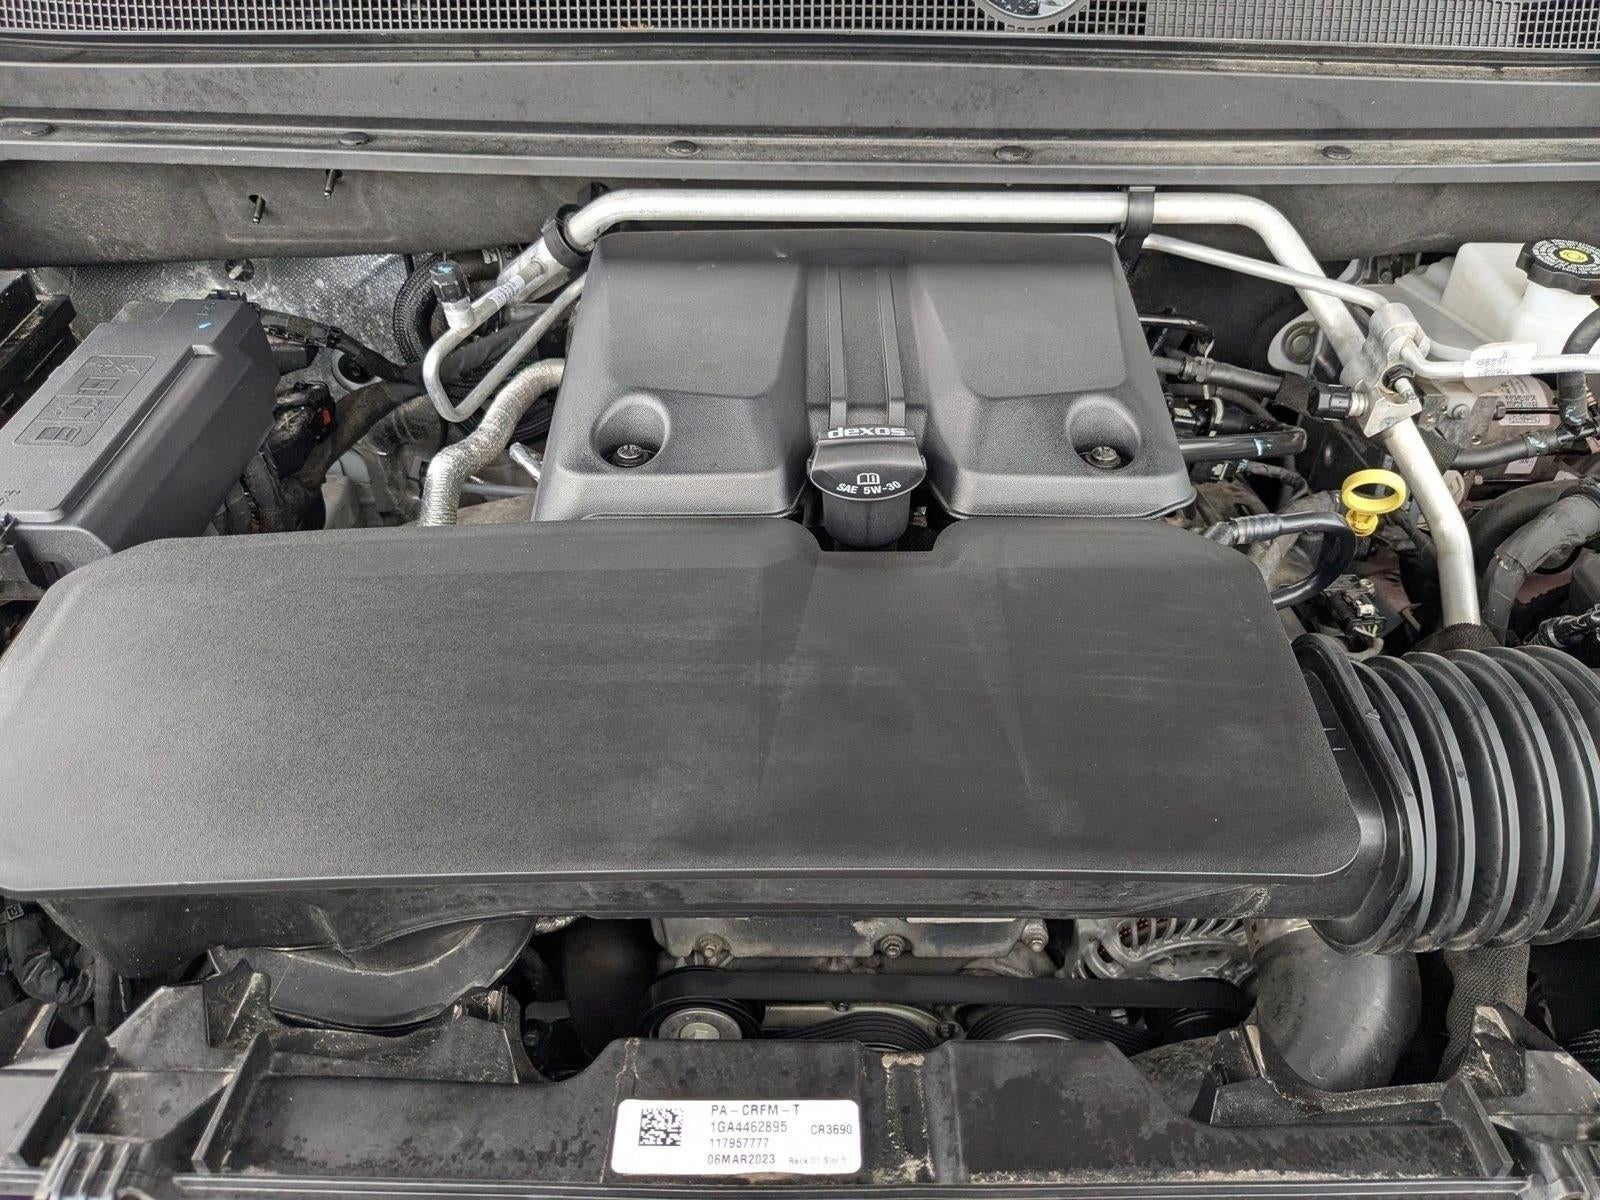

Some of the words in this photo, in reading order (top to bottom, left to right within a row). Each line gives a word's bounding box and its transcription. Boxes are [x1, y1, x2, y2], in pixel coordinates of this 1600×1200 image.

[828, 427, 906, 438] dexos
[836, 483, 858, 494] SAE
[863, 480, 901, 494] 5W-30
[711, 1121, 788, 1133] 1GA4462895
[810, 1124, 853, 1135] CR3690
[709, 1137, 770, 1148] 117957777
[707, 1153, 776, 1165] 06MAR2023
